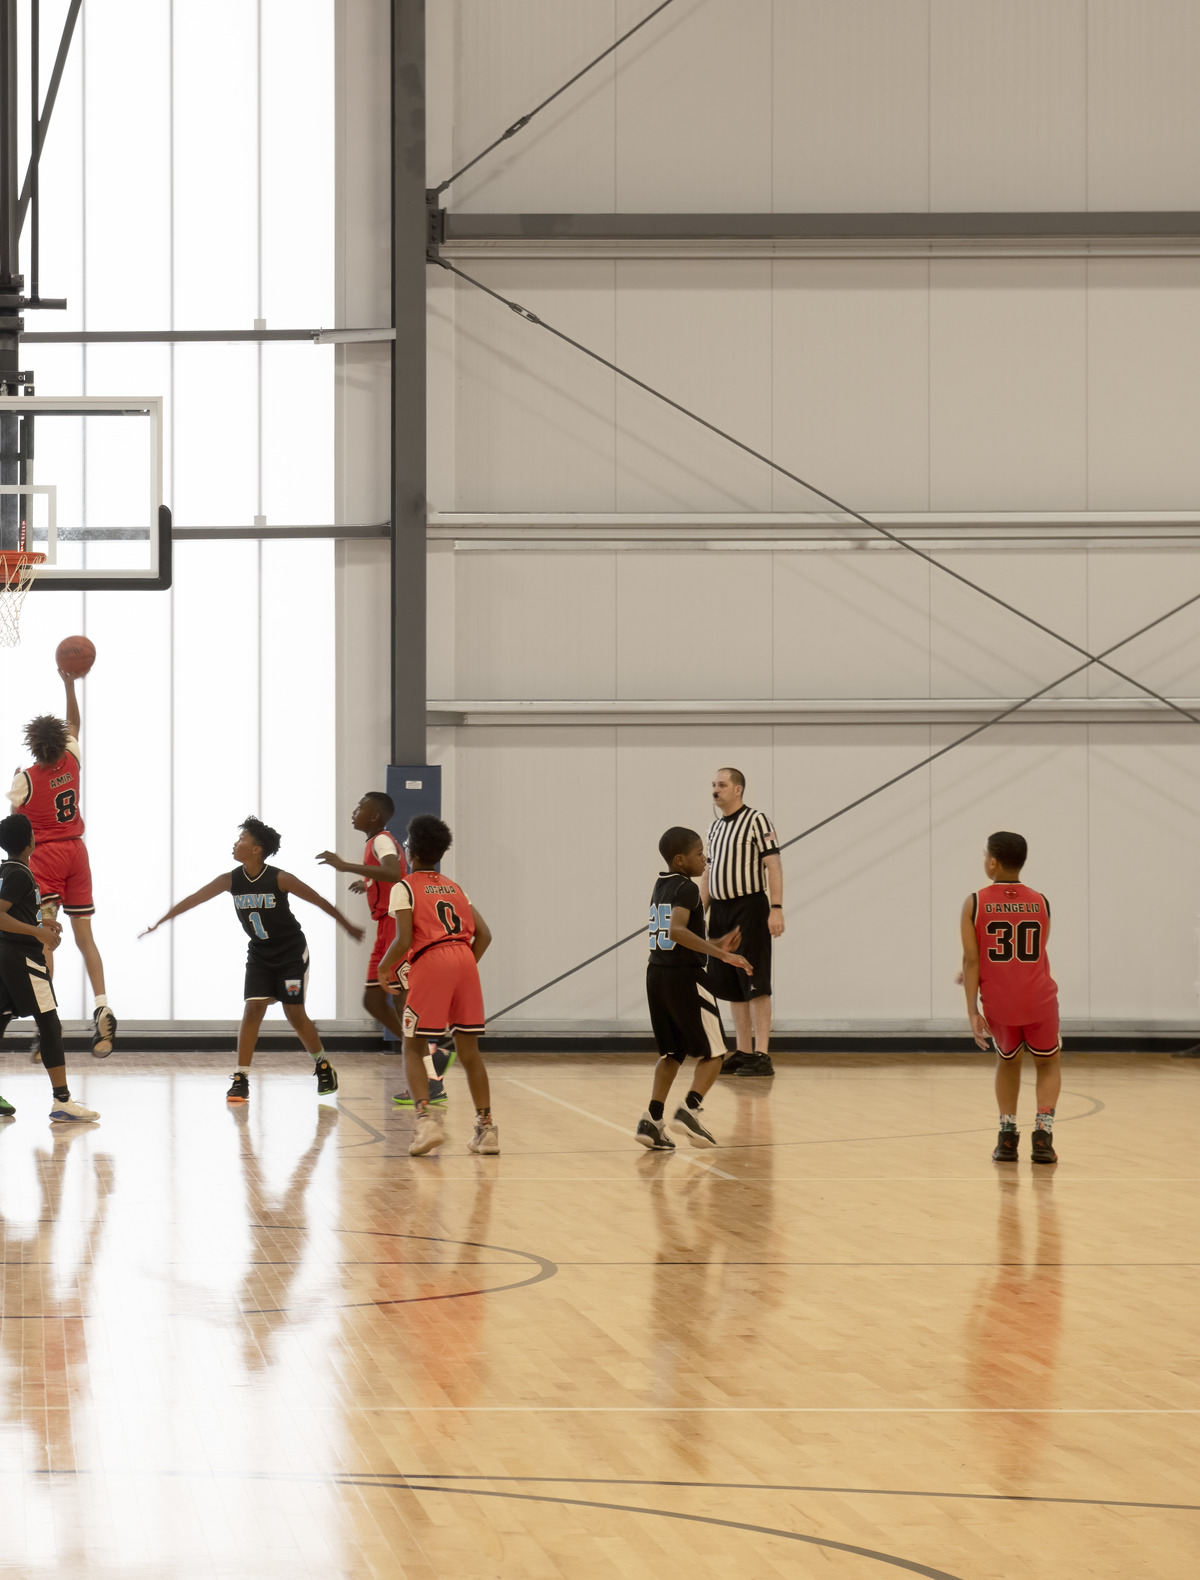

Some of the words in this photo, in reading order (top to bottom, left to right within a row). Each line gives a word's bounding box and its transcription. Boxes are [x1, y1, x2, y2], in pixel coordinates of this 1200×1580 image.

[50, 772, 73, 789] AMIR
[54, 788, 77, 823] 8
[234, 893, 277, 909] WAVE
[985, 903, 1040, 913] D'ANGELIO
[248, 911, 269, 940] 1
[435, 900, 462, 935] 0
[986, 921, 1042, 962] 30
